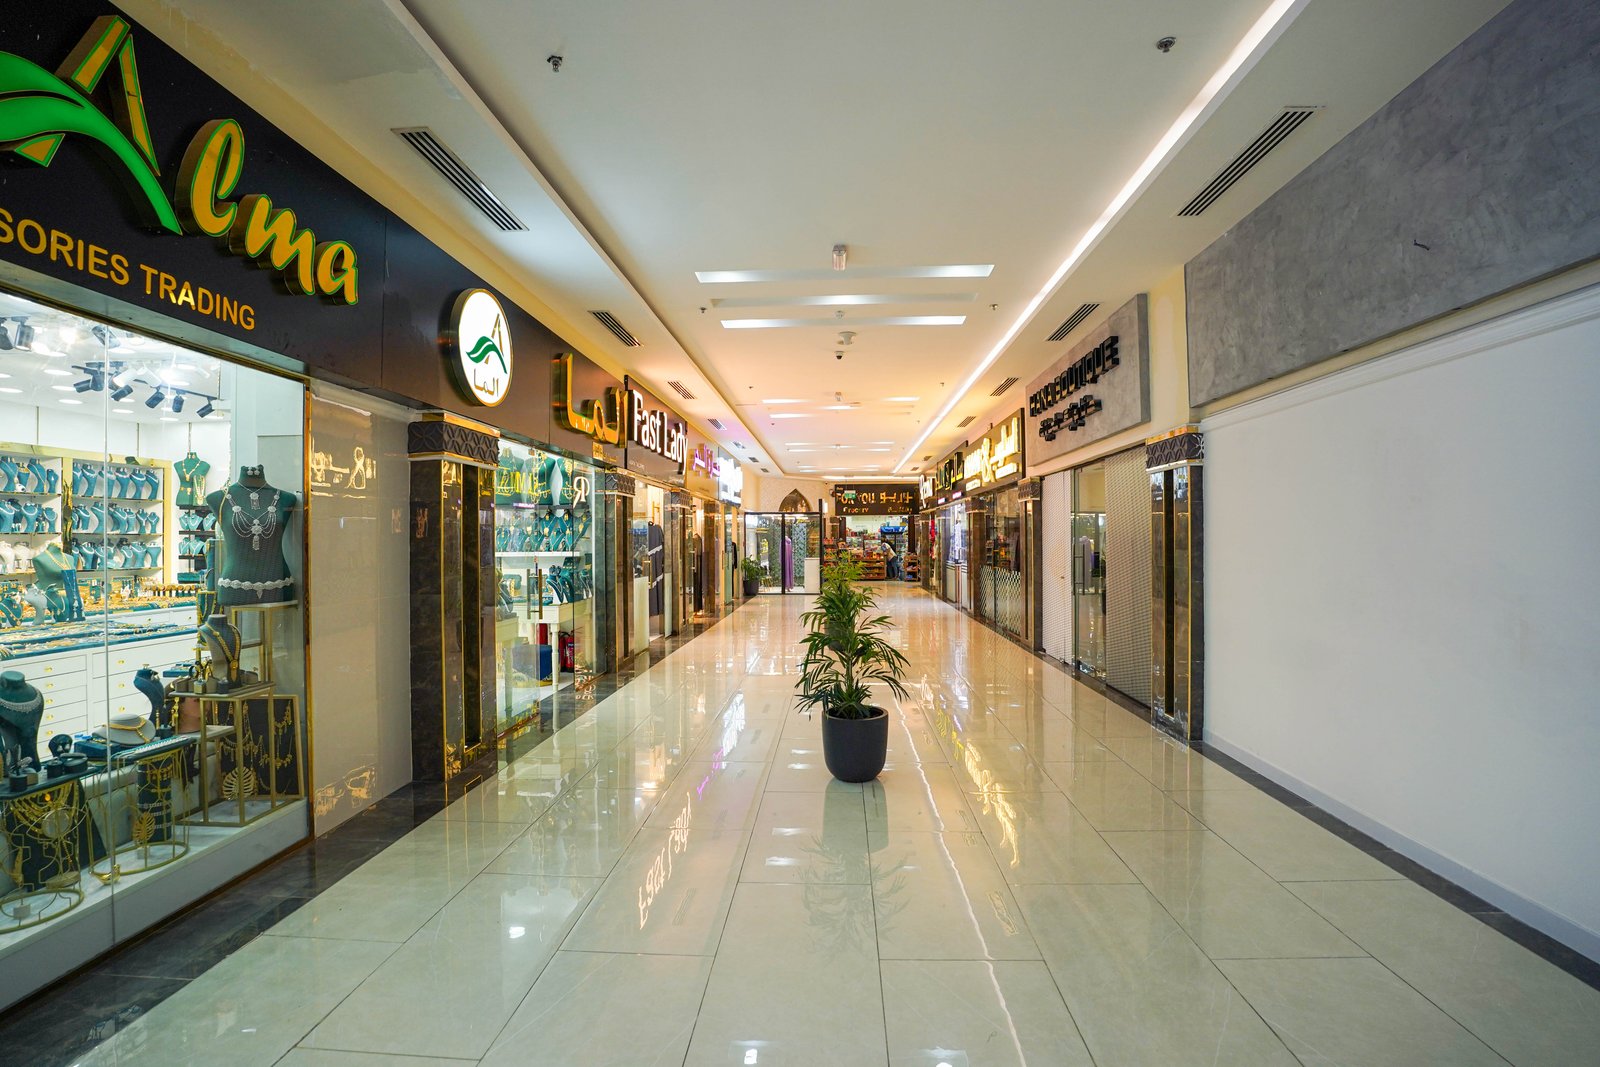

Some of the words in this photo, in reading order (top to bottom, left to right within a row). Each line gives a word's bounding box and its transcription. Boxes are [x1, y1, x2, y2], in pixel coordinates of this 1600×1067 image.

[140, 263, 256, 331] TRADING
[473, 368, 500, 397] الما
[558, 352, 629, 447] الما
[1055, 335, 1120, 405] BOUTIQUE
[632, 389, 662, 452] Fast
[663, 411, 689, 475] Lady
